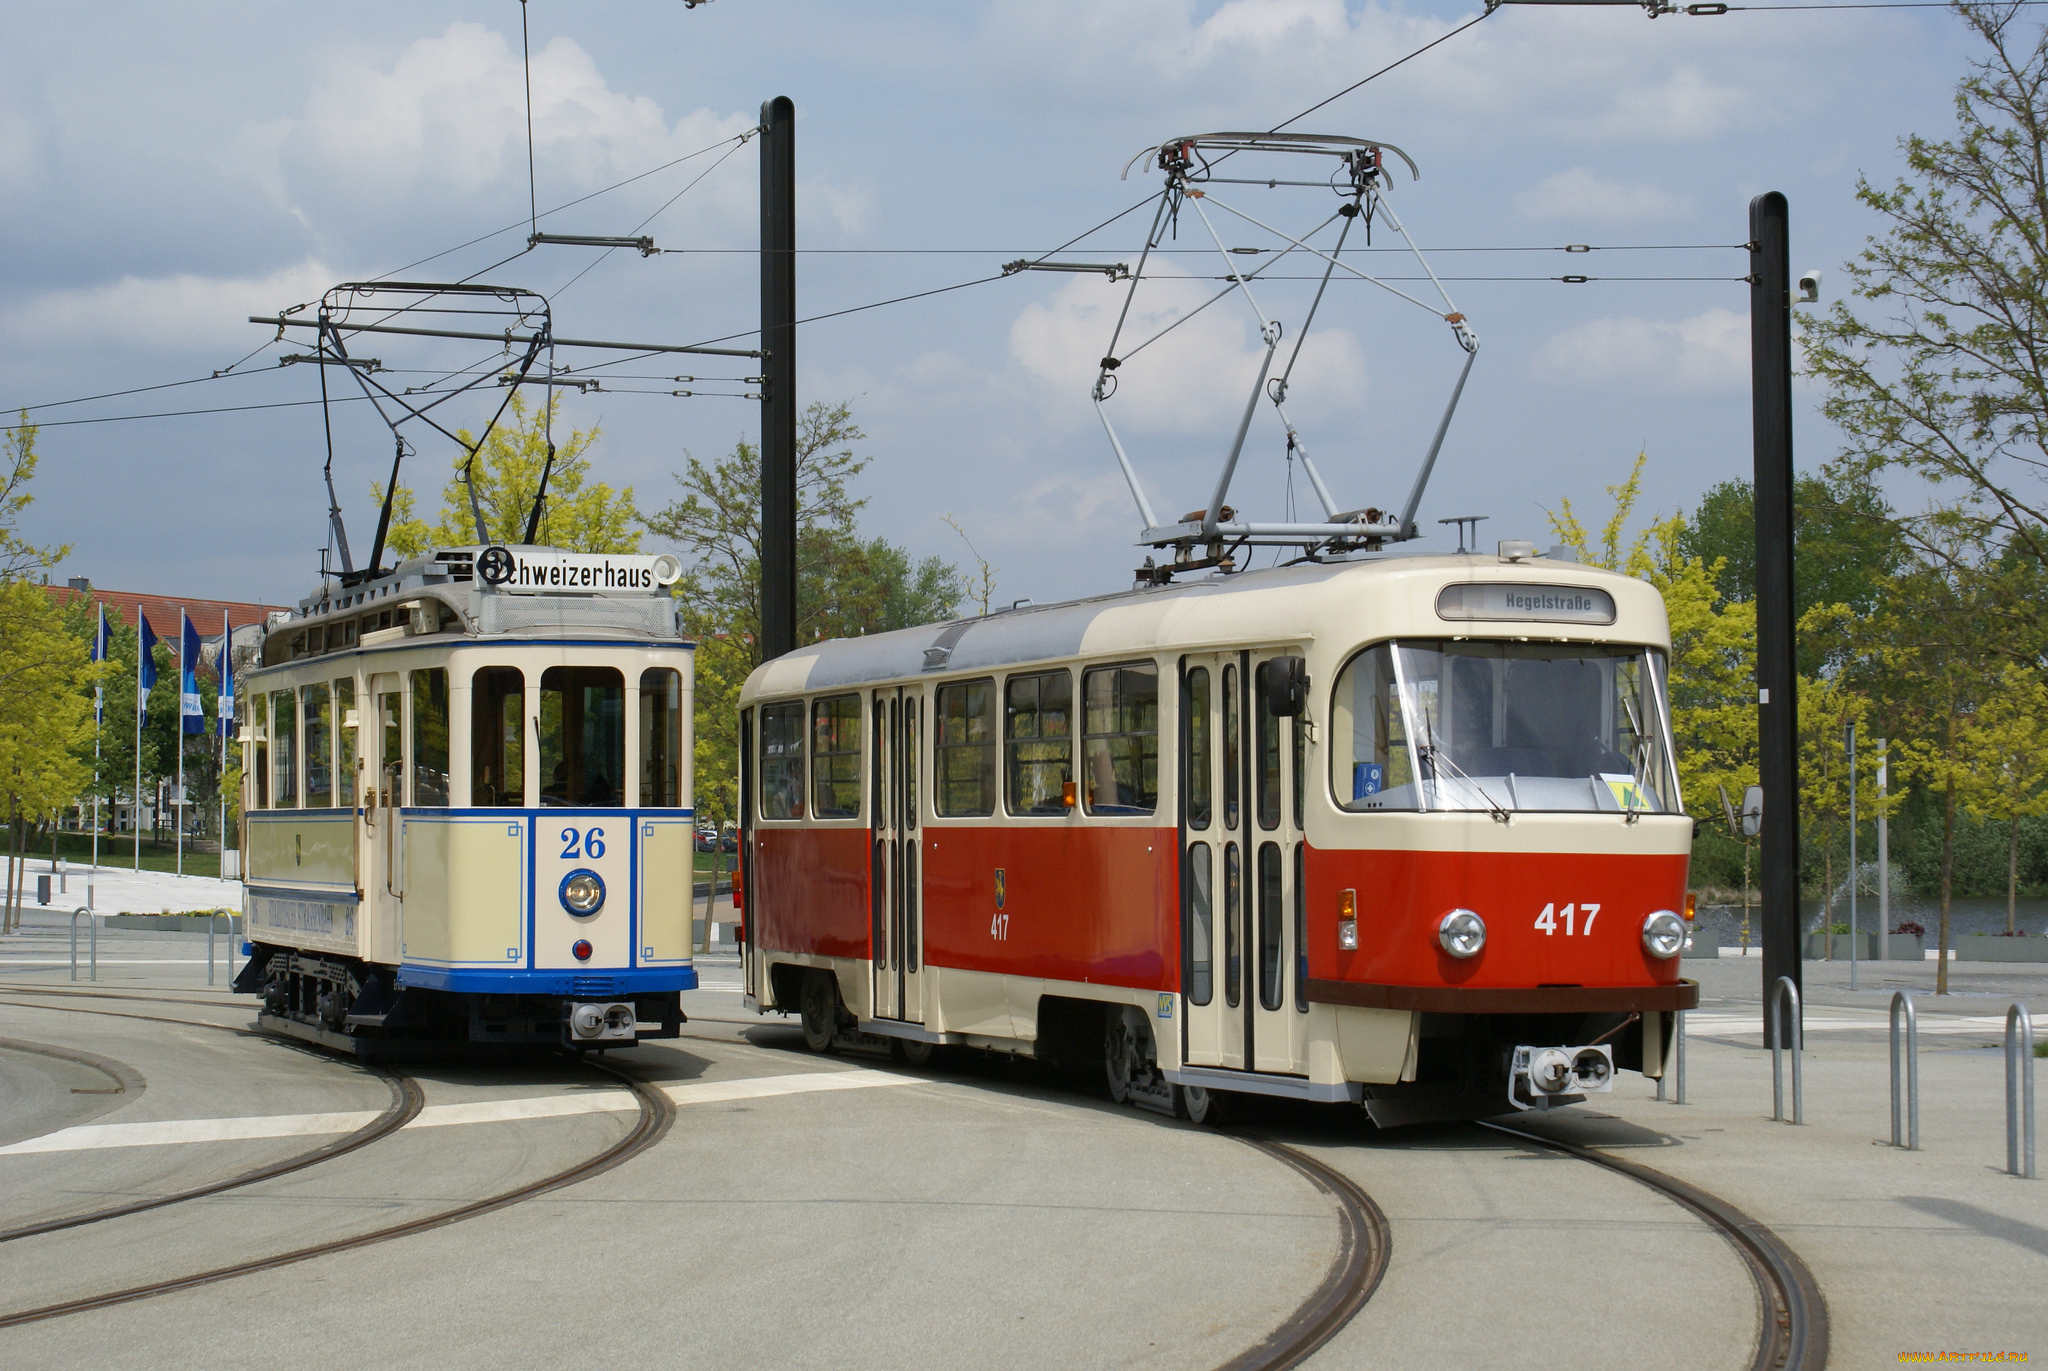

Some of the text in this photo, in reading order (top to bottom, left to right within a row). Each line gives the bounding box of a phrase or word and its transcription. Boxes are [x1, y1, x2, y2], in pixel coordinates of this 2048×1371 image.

[508, 558, 651, 588] chweizerhaus
[1506, 592, 1591, 611] Hegelstraße
[560, 827, 606, 859] 26
[990, 913, 1009, 941] 417
[1534, 903, 1601, 936] 417
